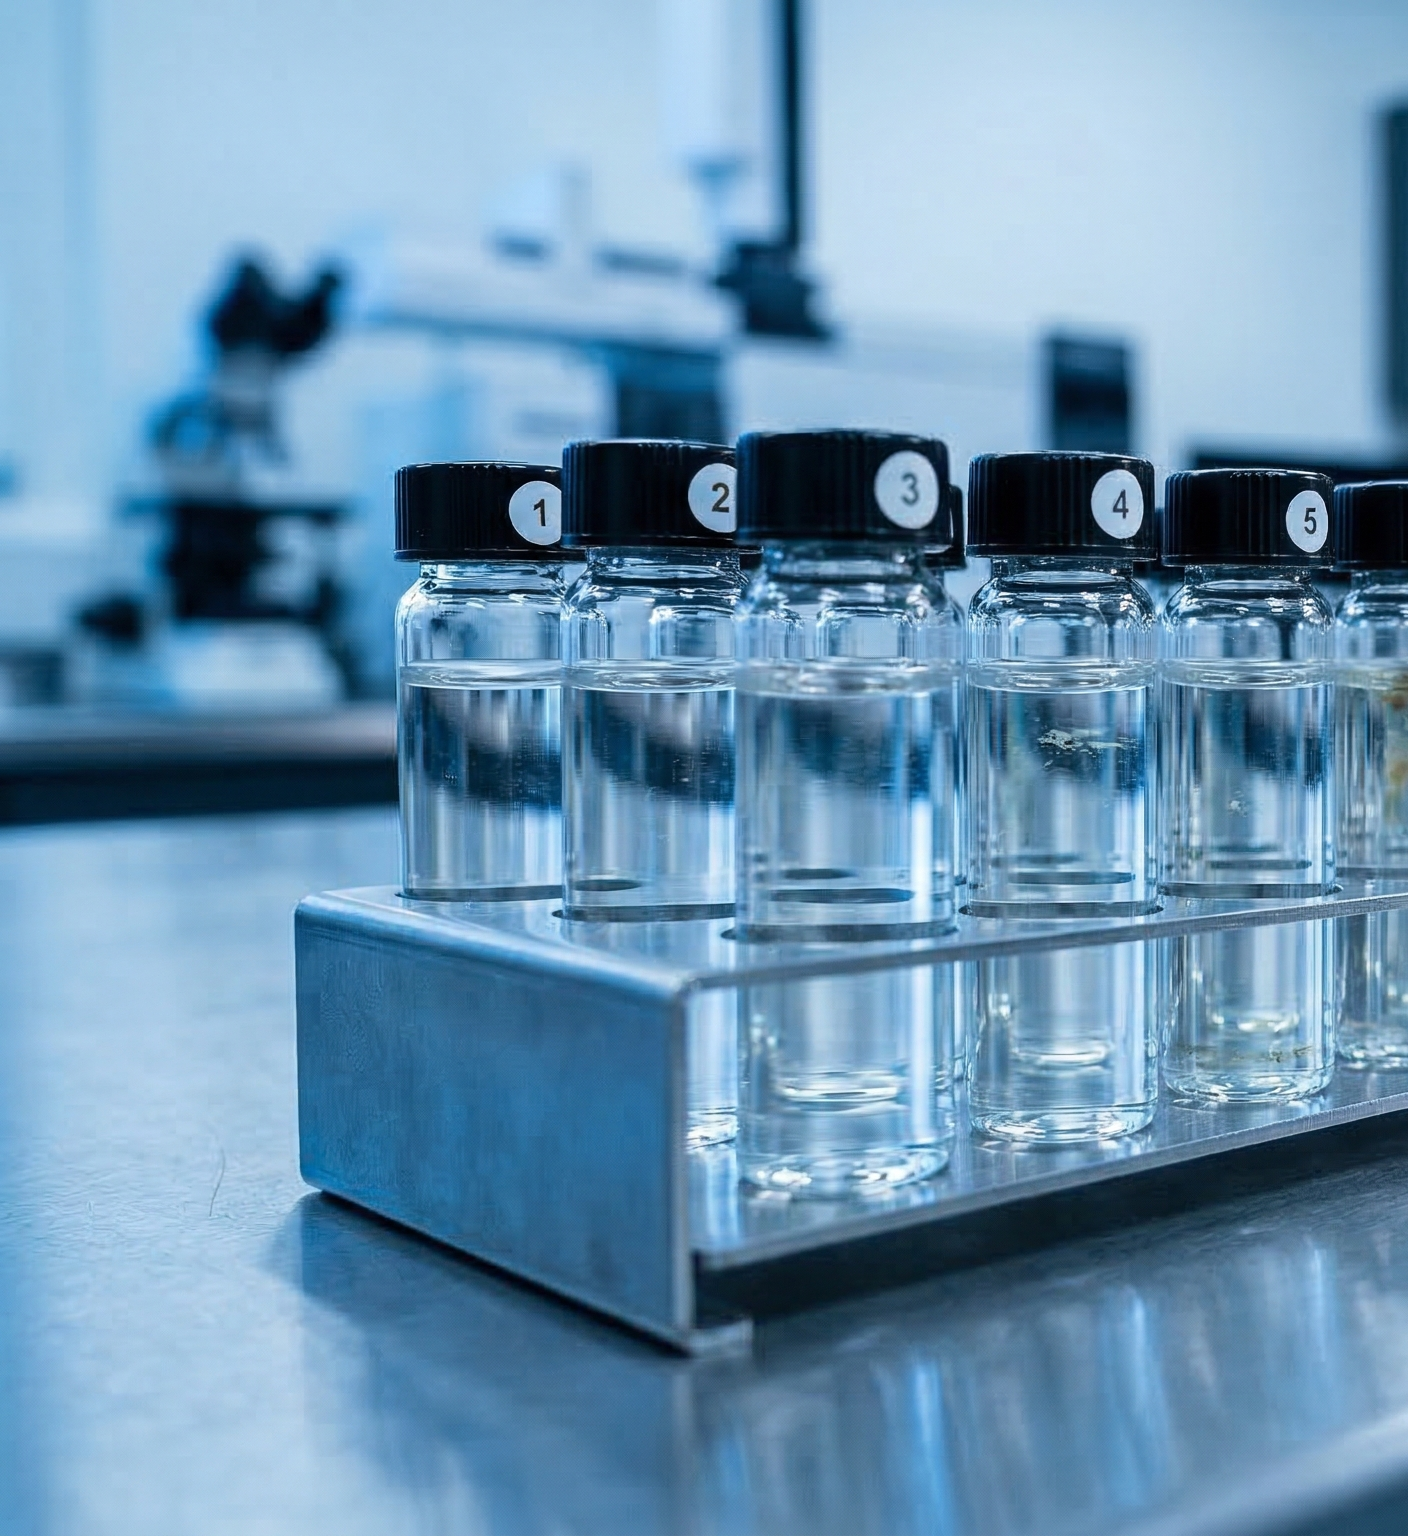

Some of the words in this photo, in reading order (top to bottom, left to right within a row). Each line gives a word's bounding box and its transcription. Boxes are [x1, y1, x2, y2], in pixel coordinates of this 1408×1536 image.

[711, 483, 730, 513] 2
[901, 473, 920, 506] 3
[1112, 489, 1129, 519] 4
[533, 499, 547, 526] 1
[1304, 508, 1317, 535] 5
